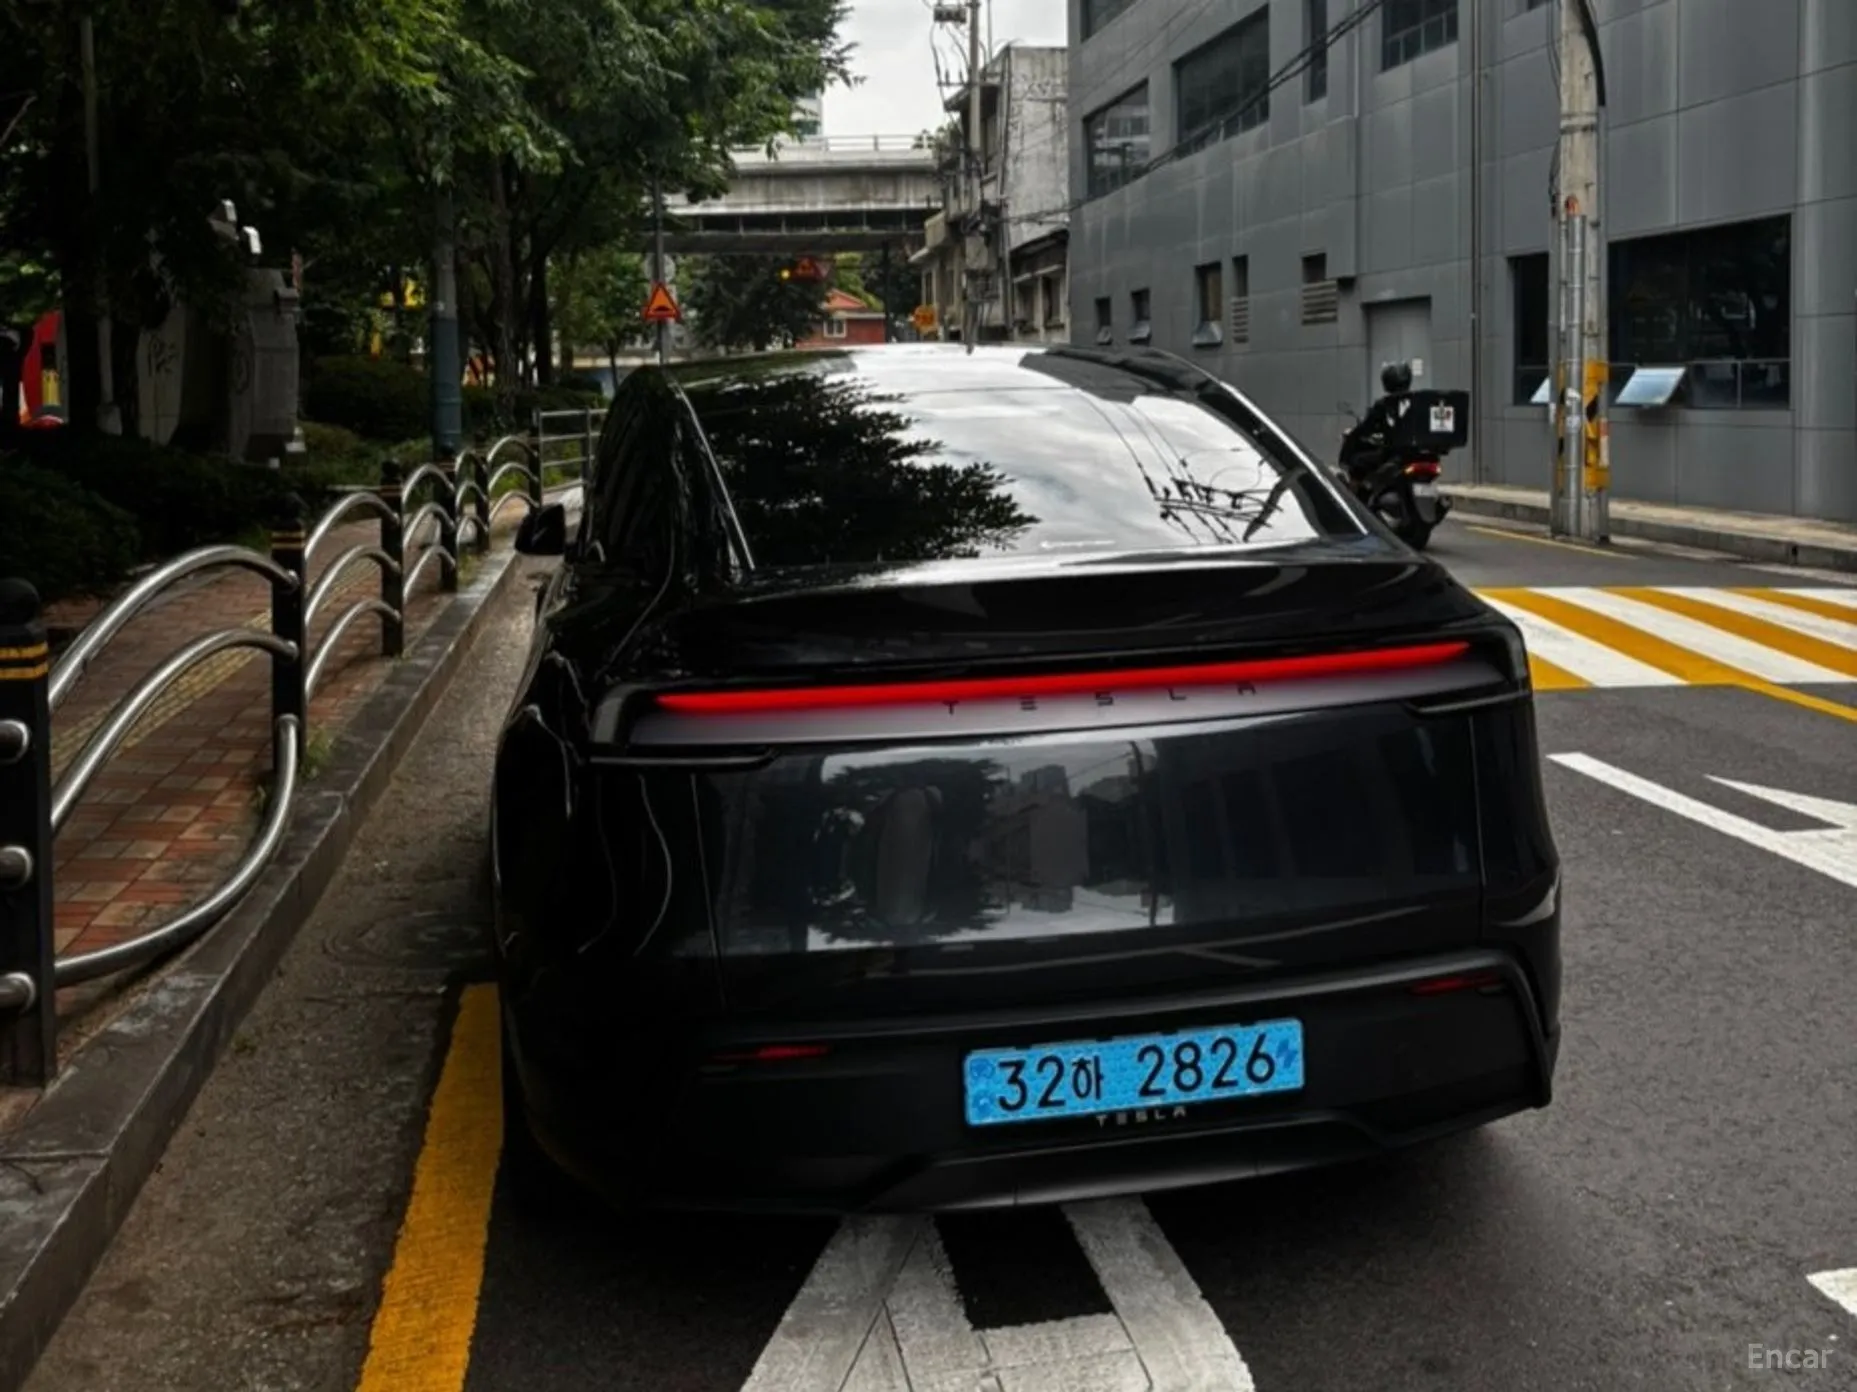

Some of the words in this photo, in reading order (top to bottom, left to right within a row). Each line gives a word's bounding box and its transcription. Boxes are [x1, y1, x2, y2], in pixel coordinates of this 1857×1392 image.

[943, 682, 1257, 715] TESLA
[997, 1055, 1104, 1112] 32하
[1137, 1032, 1276, 1098] 2826
[1095, 1107, 1187, 1127] TESLA
